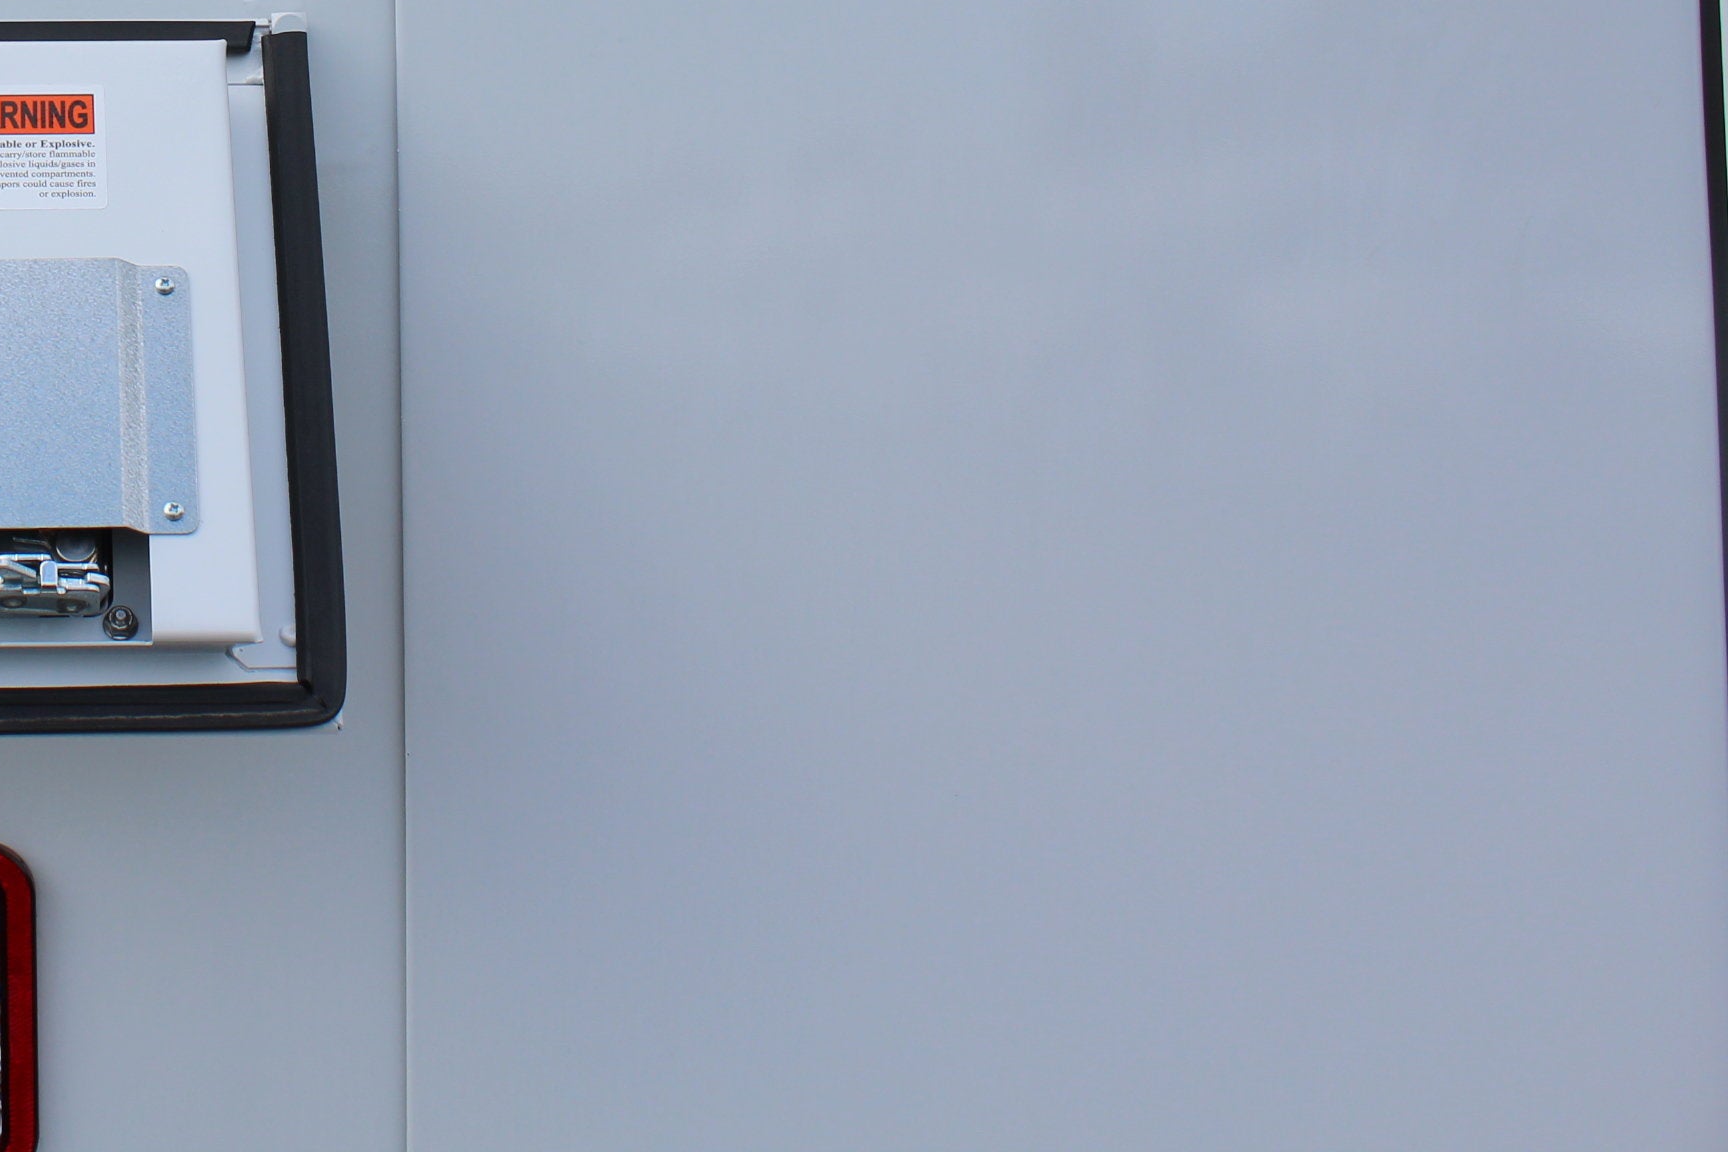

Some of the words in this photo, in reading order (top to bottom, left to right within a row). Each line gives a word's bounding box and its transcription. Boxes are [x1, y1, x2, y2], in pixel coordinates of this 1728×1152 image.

[41, 140, 95, 149] Explosive.
[0, 151, 46, 160] carry/store
[29, 161, 85, 169] liquids/gases
[31, 171, 95, 179] compartments.
[51, 190, 96, 199] explosion.
